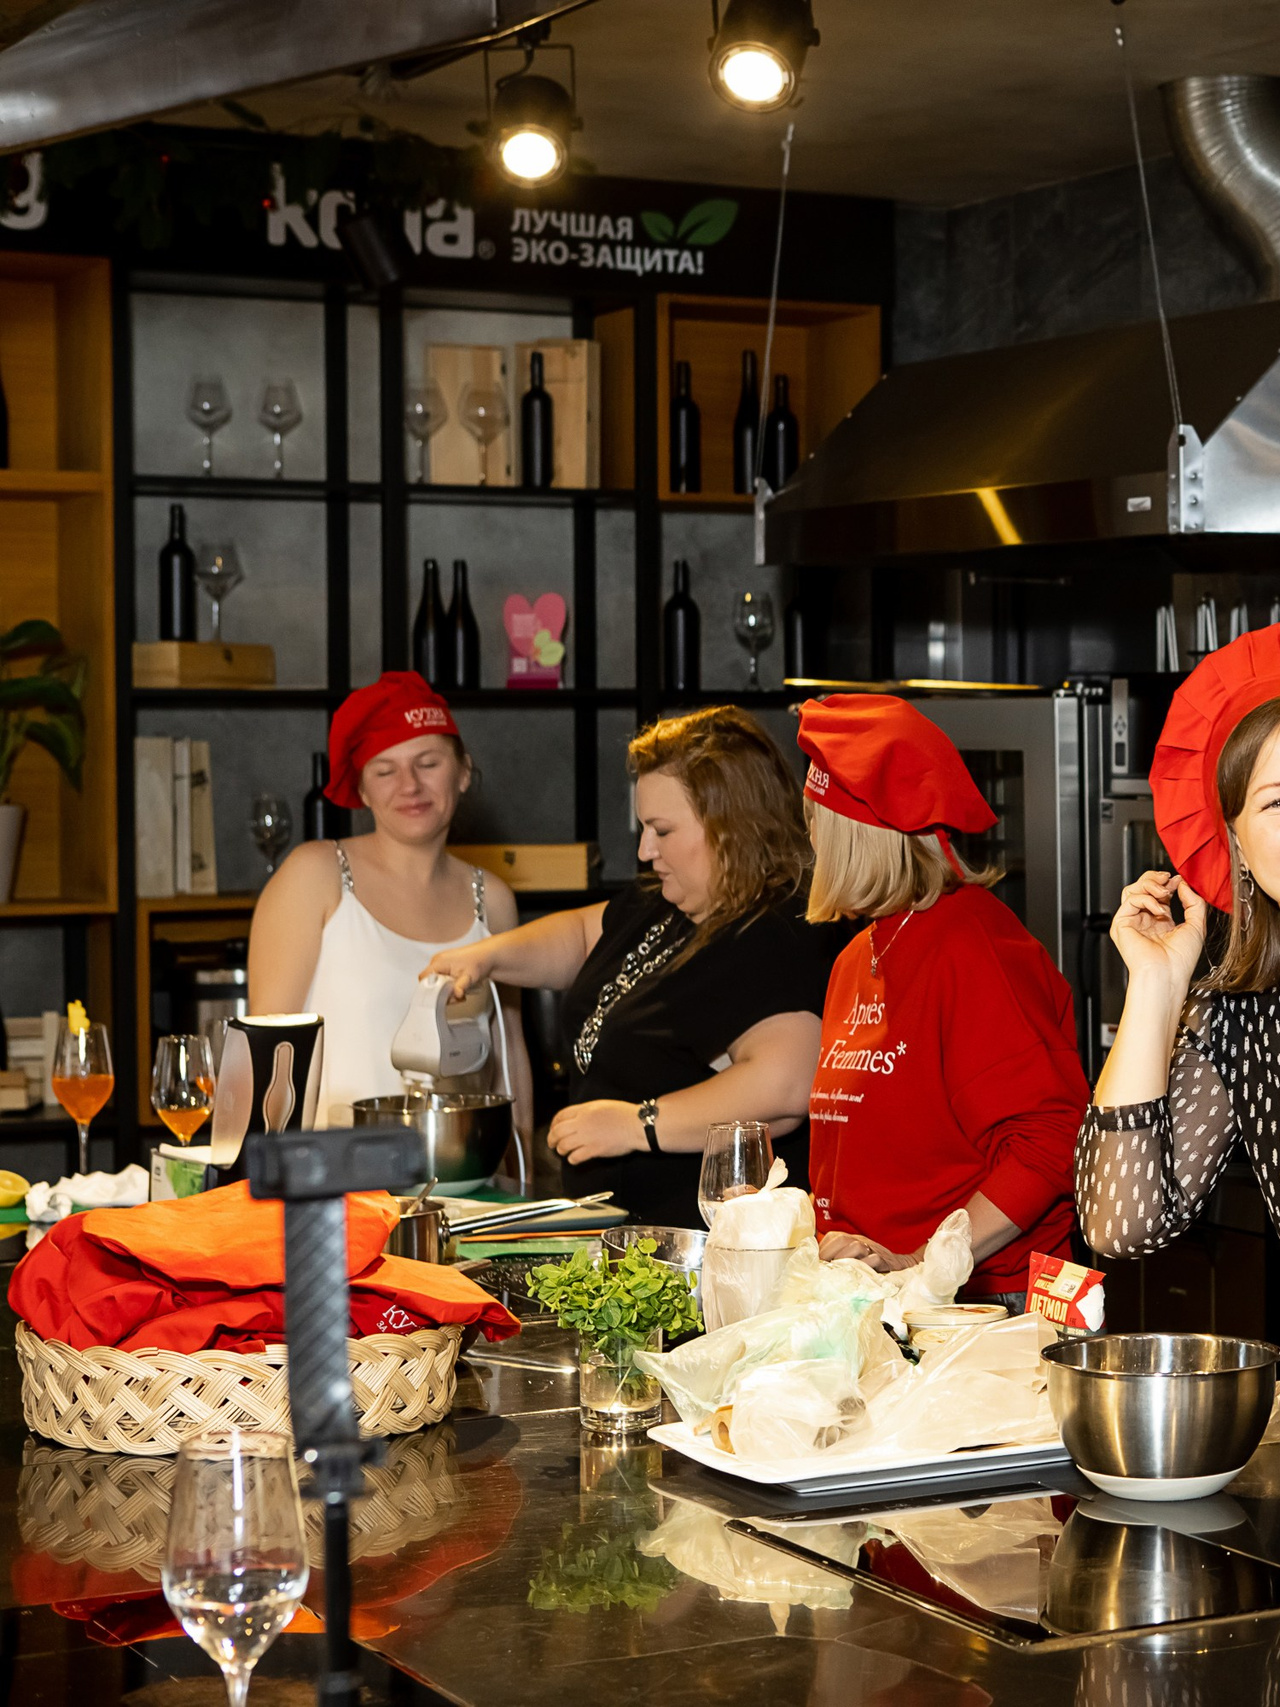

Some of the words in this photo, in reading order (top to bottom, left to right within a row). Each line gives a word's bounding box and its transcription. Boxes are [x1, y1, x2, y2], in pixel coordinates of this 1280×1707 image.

[510, 207, 634, 242] ЛУЧШАЯ
[510, 237, 705, 278] ЭКО-ЗАЩИТА!
[843, 992, 886, 1036] Après
